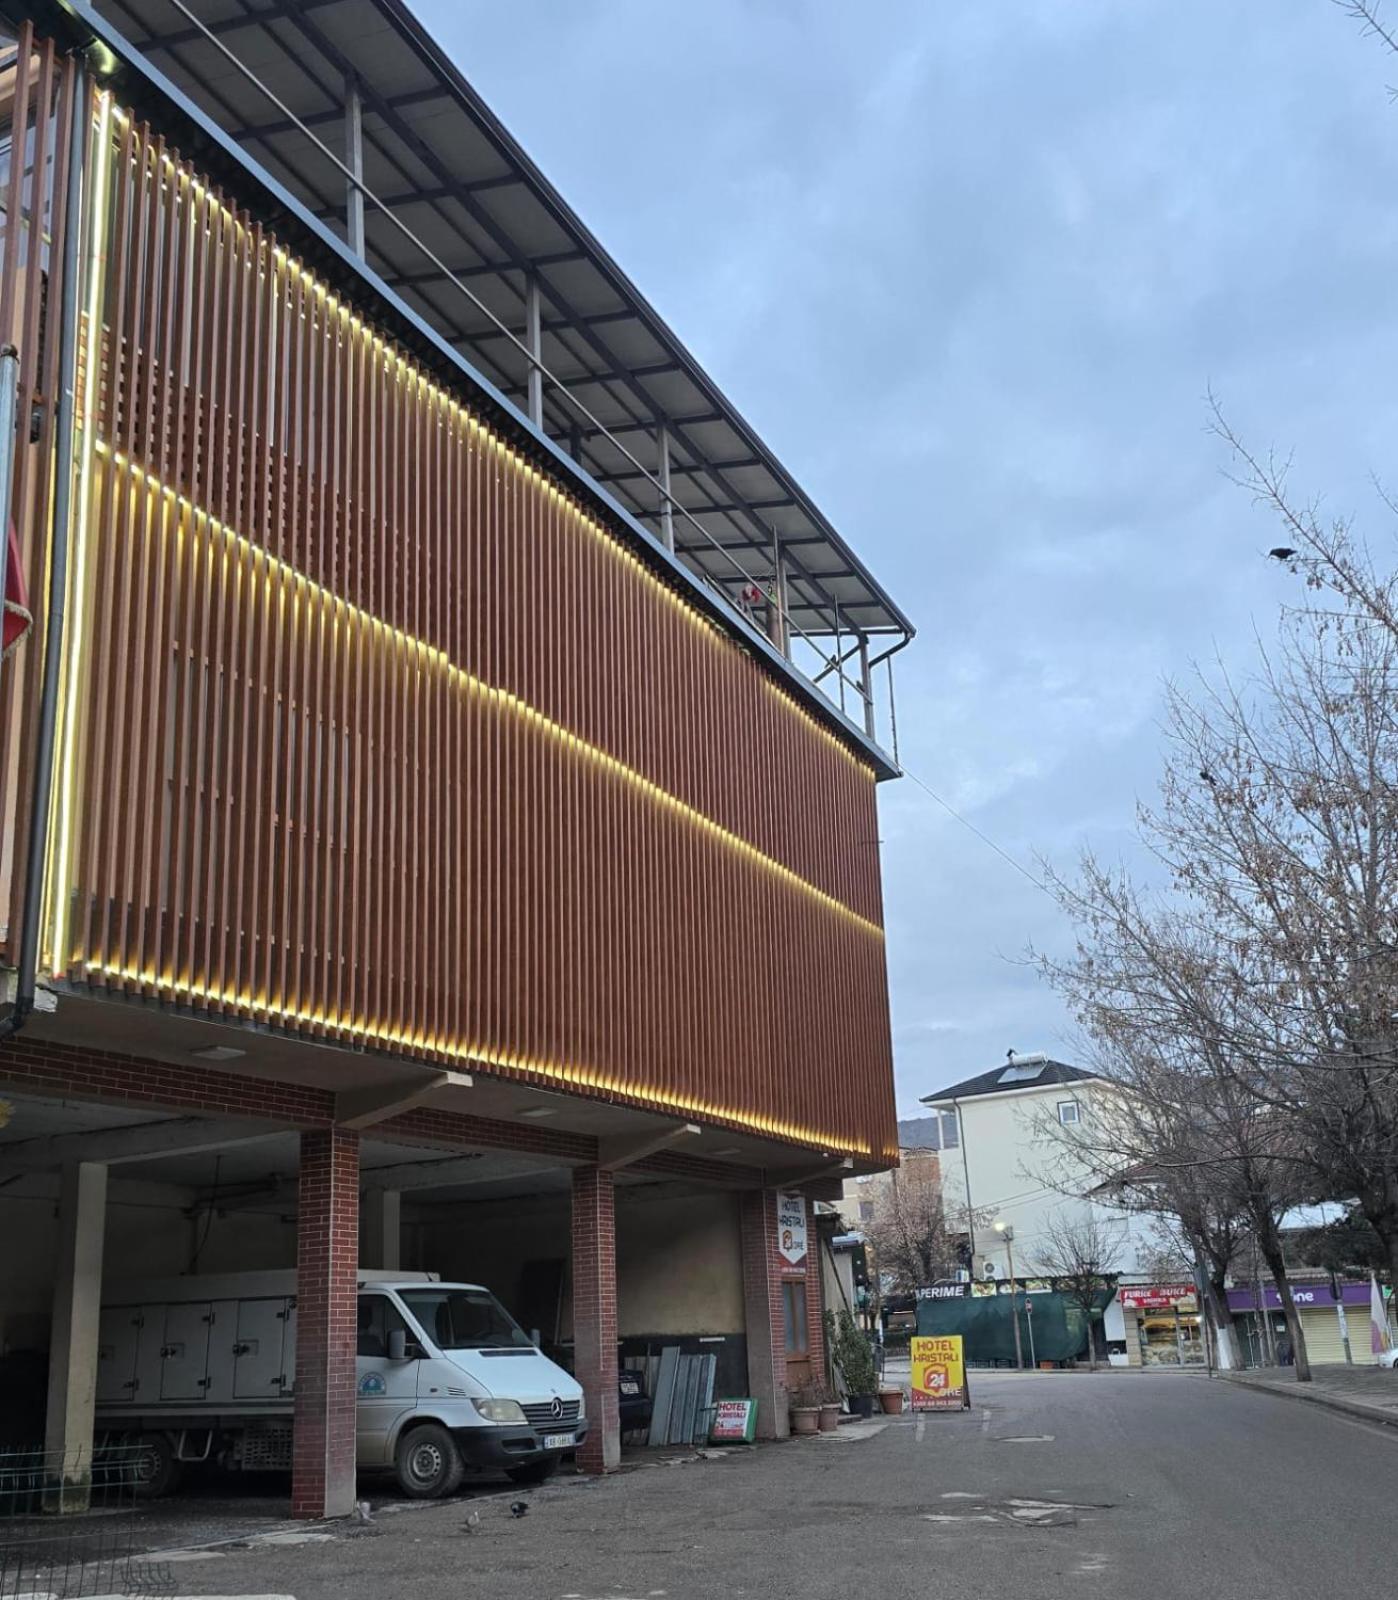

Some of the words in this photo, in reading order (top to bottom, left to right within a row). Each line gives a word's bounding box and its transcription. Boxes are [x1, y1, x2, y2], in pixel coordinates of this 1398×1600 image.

[917, 1340, 955, 1352] HOTEL
[928, 1374, 946, 1388] 24
[719, 1402, 746, 1411] HOTEL
